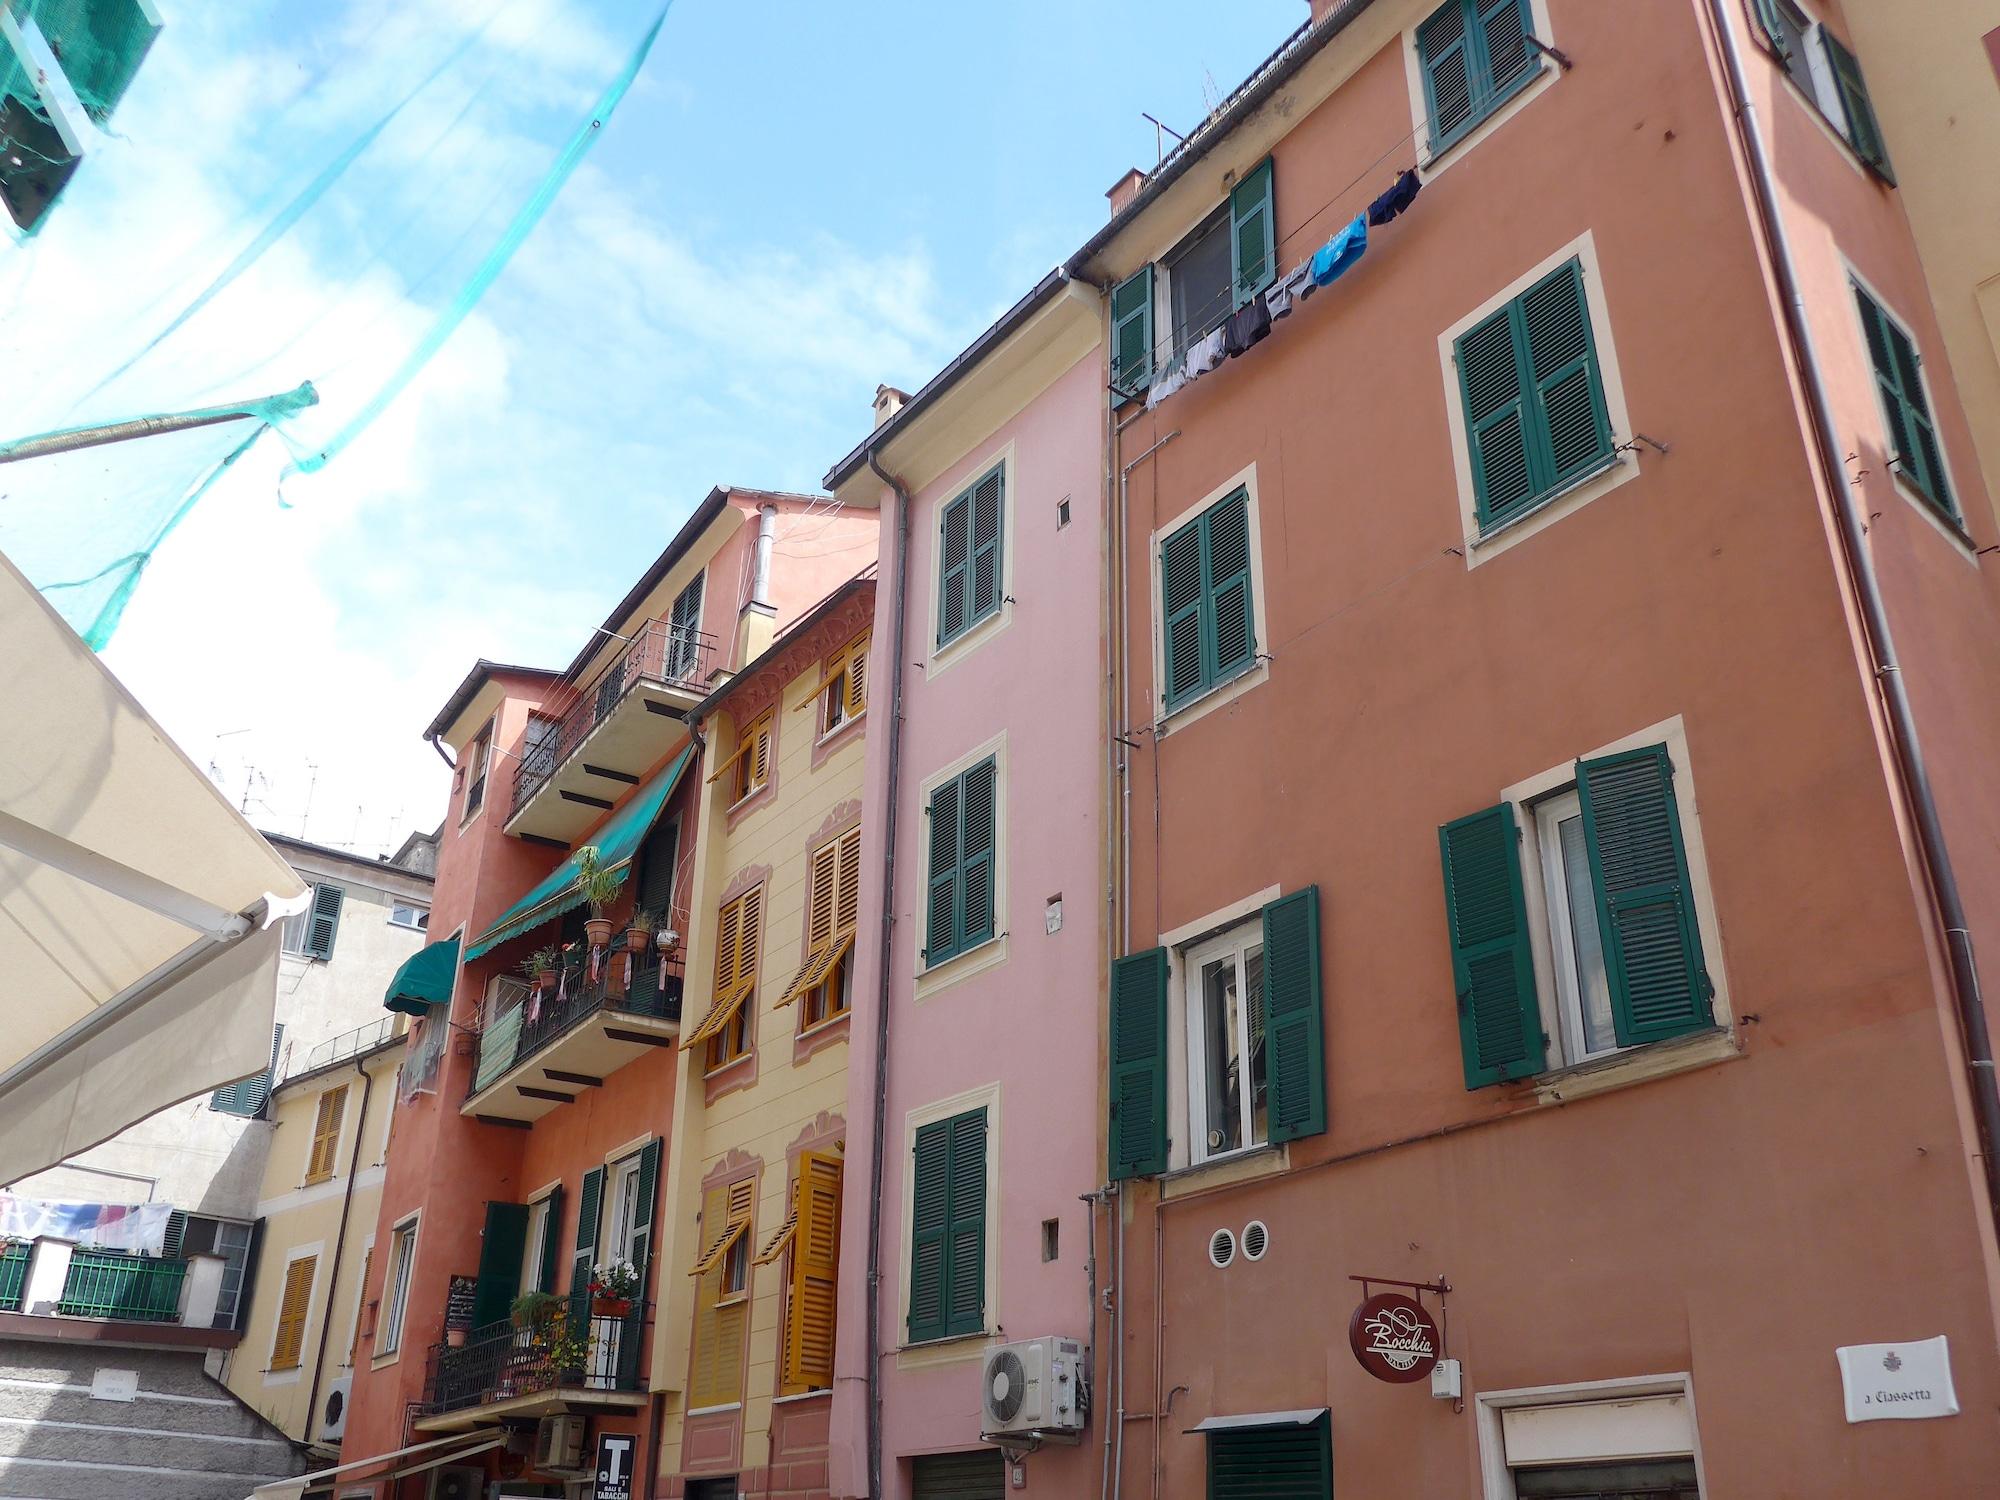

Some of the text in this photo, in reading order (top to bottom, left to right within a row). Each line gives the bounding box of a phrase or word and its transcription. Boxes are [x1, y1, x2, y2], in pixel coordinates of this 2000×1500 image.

[1365, 1323, 1433, 1352] Bocchia
[1876, 1390, 1931, 1403] Ciassetta
[605, 1439, 630, 1484] T
[597, 1491, 628, 1499] TABACCHI
